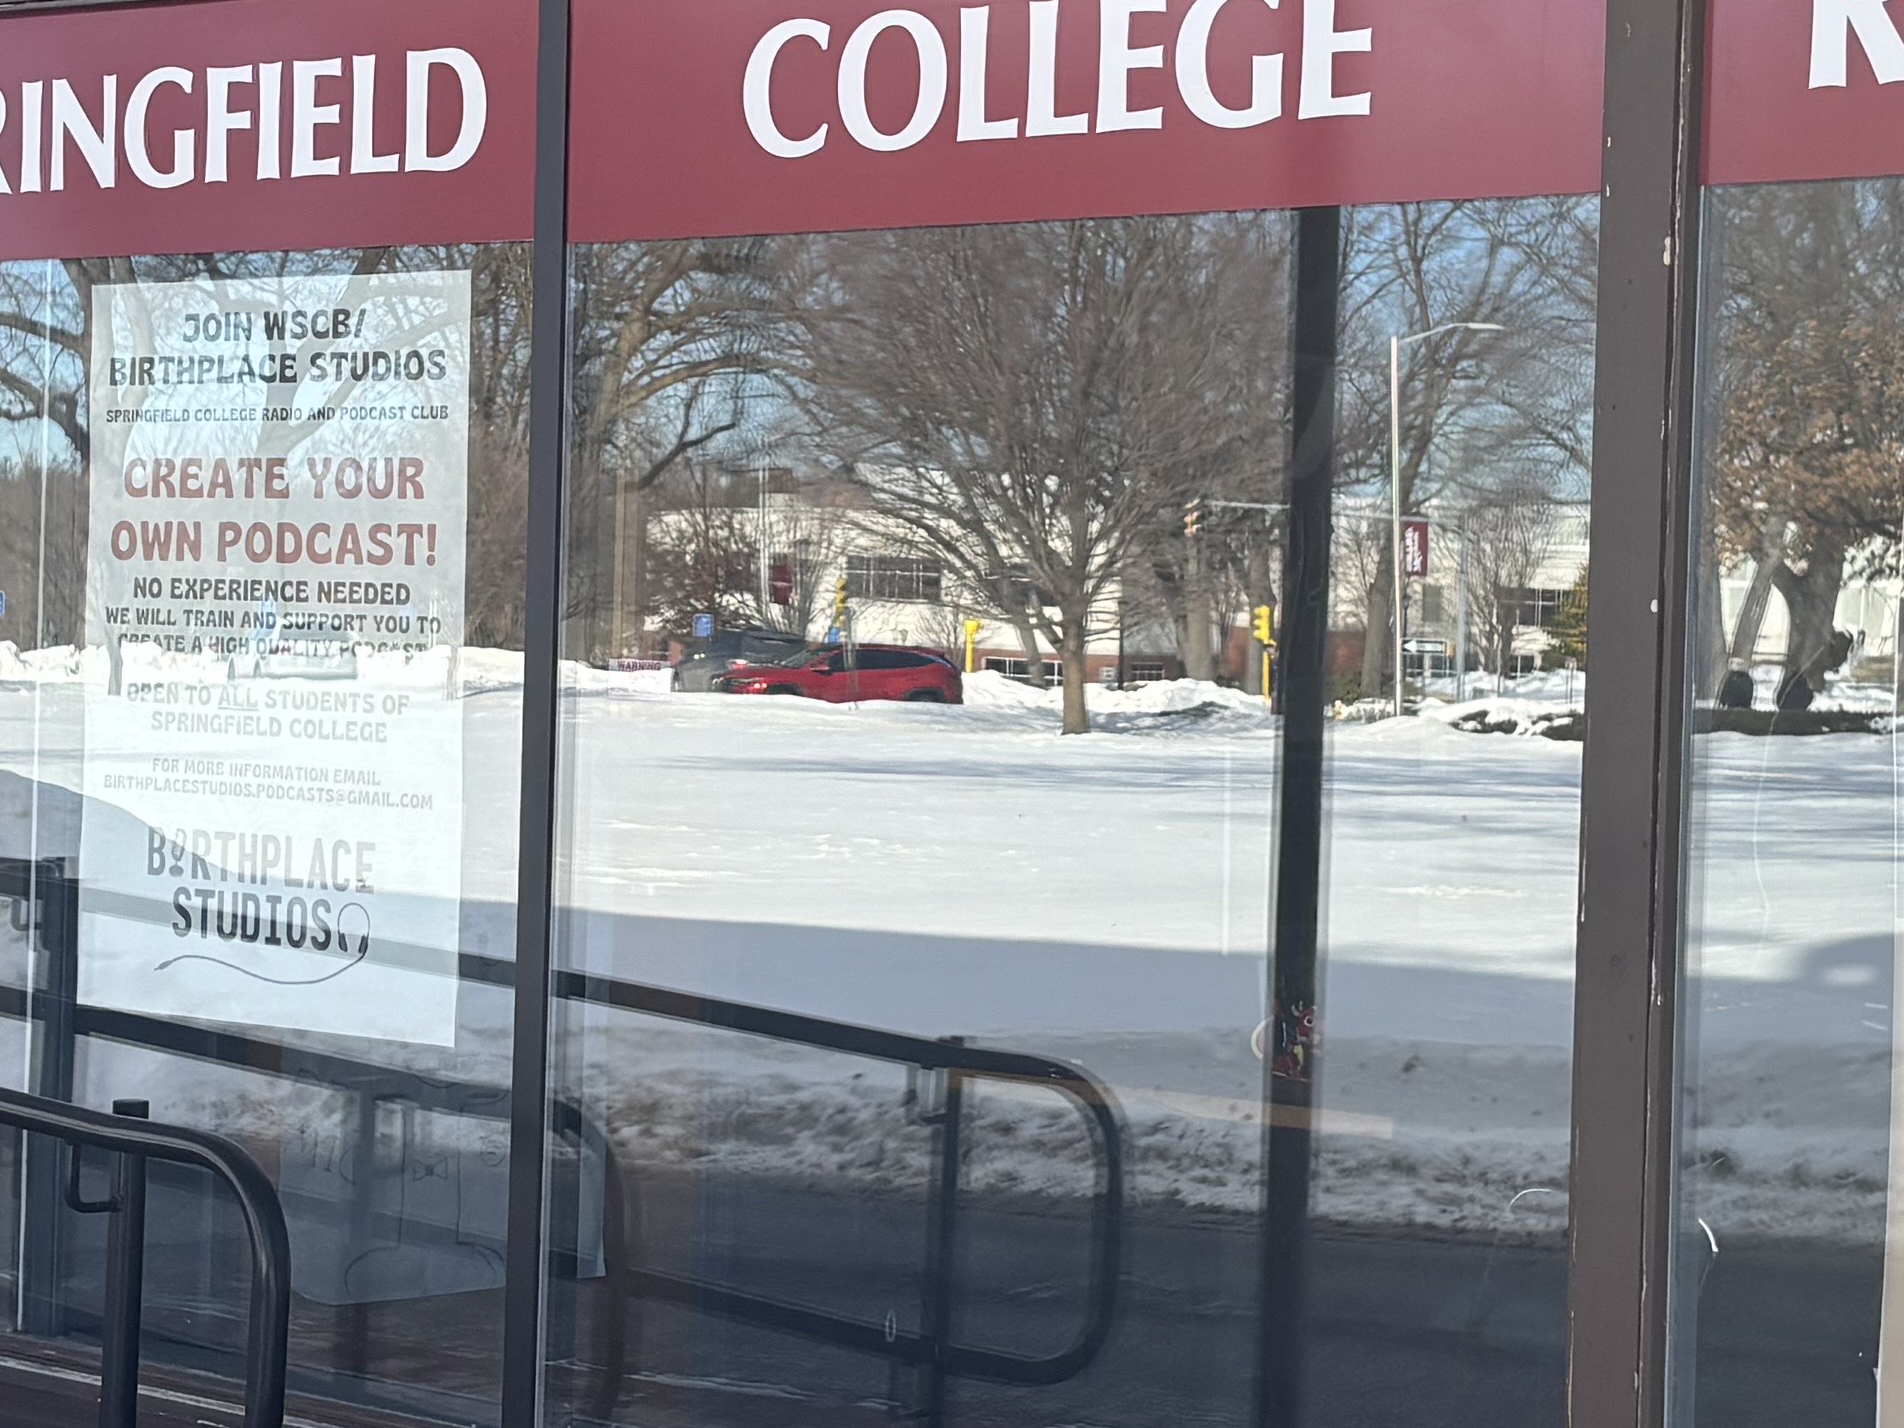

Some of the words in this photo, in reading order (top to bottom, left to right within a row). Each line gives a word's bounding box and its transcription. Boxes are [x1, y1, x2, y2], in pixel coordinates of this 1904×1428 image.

[183, 311, 252, 342] JOIN
[263, 308, 367, 341] WSCB/
[109, 353, 297, 386] BIRTHPLACE
[309, 349, 446, 382] STUDIOS
[106, 408, 190, 423] SPRINGFIELD
[194, 407, 257, 422] COLLEGE
[262, 407, 302, 422] RADIO
[307, 406, 336, 421] AND
[340, 405, 407, 421] PODCAST
[411, 404, 450, 420] CLUB
[124, 457, 290, 499] CREATE
[306, 456, 425, 500] YOUR
[110, 520, 202, 562] OWN
[217, 521, 437, 567] PODCAST!
[133, 576, 163, 600] NO
[170, 578, 309, 604] EXPERIENCE
[316, 581, 411, 606] NEEDED
[105, 606, 130, 625] WE
[135, 607, 177, 627] WILL
[183, 609, 235, 629] TRAIN
[240, 611, 277, 631] AND
[282, 612, 367, 633] SUPPORT
[373, 614, 411, 635] YOU
[416, 616, 442, 635] TO
[191, 635, 203, 653] A
[617, 661, 662, 672] WARNING
[126, 682, 179, 703] OPEN
[185, 685, 211, 706] TO
[218, 686, 259, 709] ALL
[264, 689, 375, 714] STUDENTS
[382, 694, 410, 715] OF
[151, 711, 283, 738] SPRINGFIELD
[289, 717, 387, 743] COLLEGE
[152, 757, 180, 774] FOR
[184, 759, 225, 776] MORE
[229, 762, 330, 783] INFORMATION
[333, 769, 382, 786] EMAIL
[104, 774, 434, 811] BIRTHPLACESTUDIOS.PODCASTS@GMAIL.COM
[171, 886, 332, 952] STUDIOS
